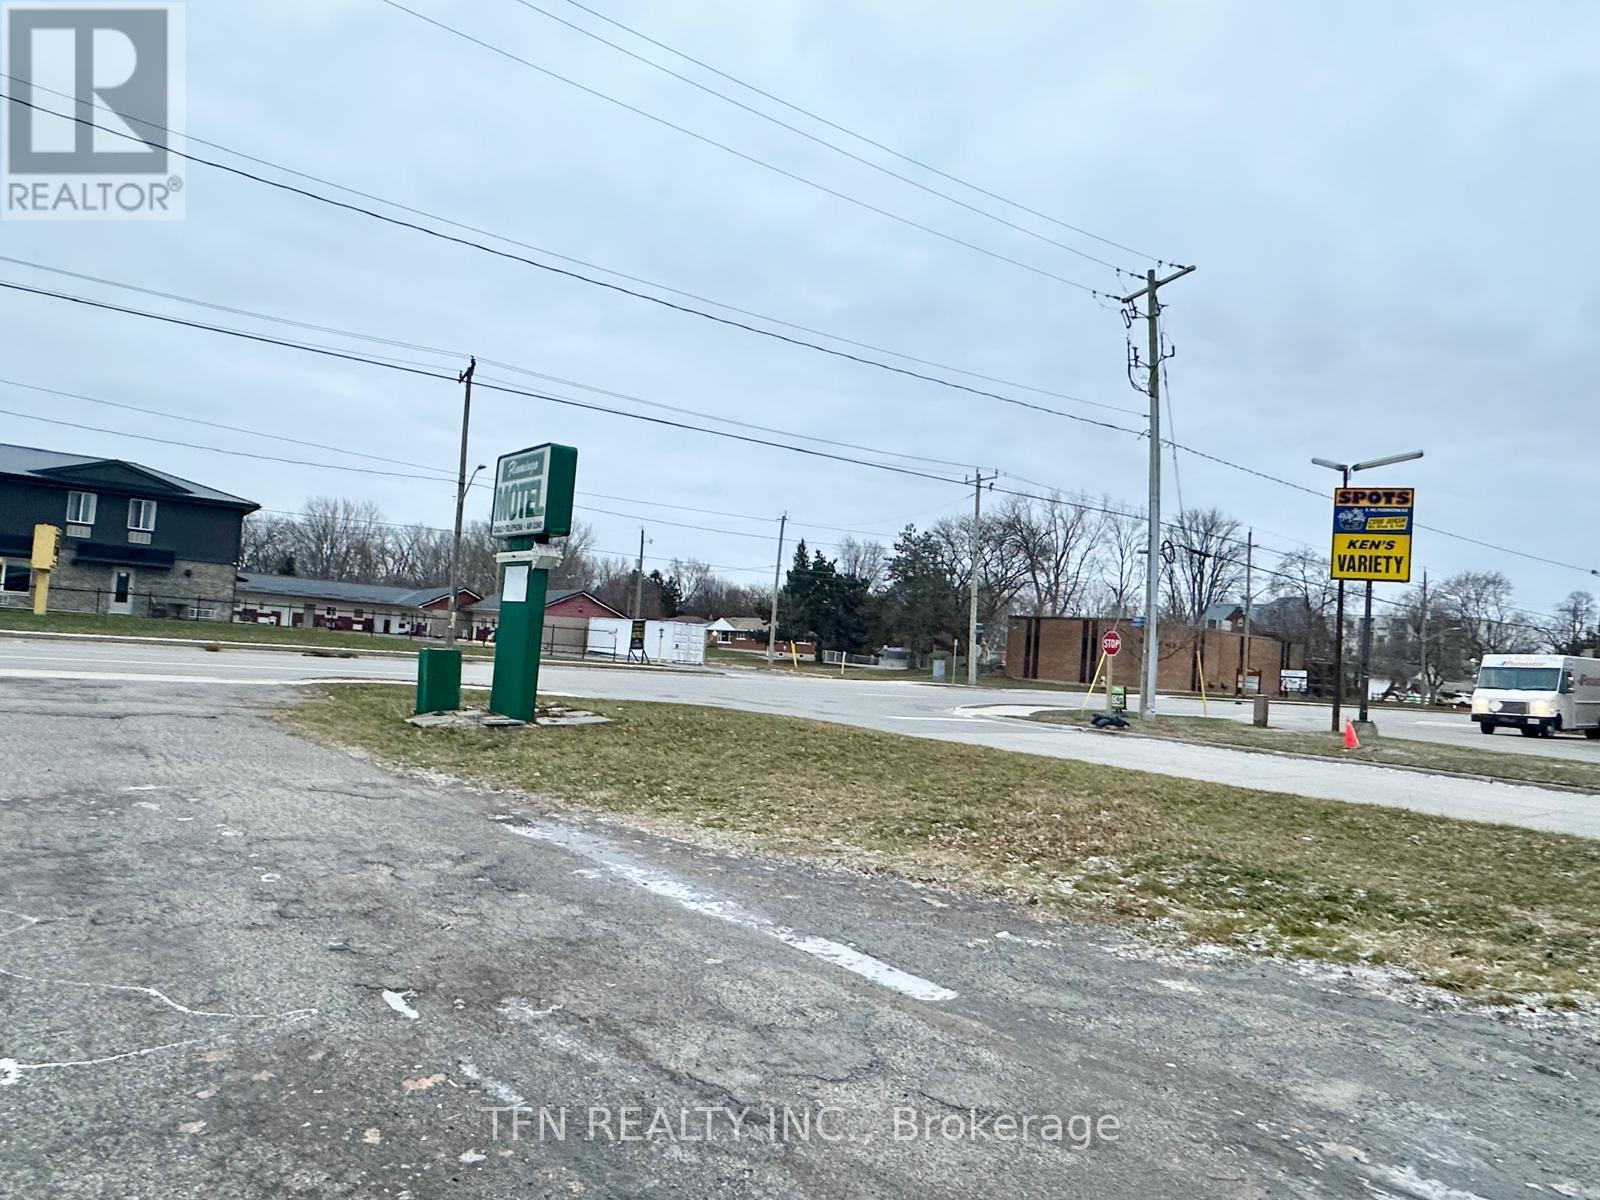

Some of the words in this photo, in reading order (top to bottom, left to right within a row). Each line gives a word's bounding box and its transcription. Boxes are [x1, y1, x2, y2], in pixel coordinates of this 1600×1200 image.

[495, 479, 544, 521] MOTEL
[1338, 491, 1410, 504] SPOTS
[1347, 540, 1396, 549] KEN'S
[1337, 553, 1404, 574] VARIETY
[1103, 638, 1121, 649] STOP
